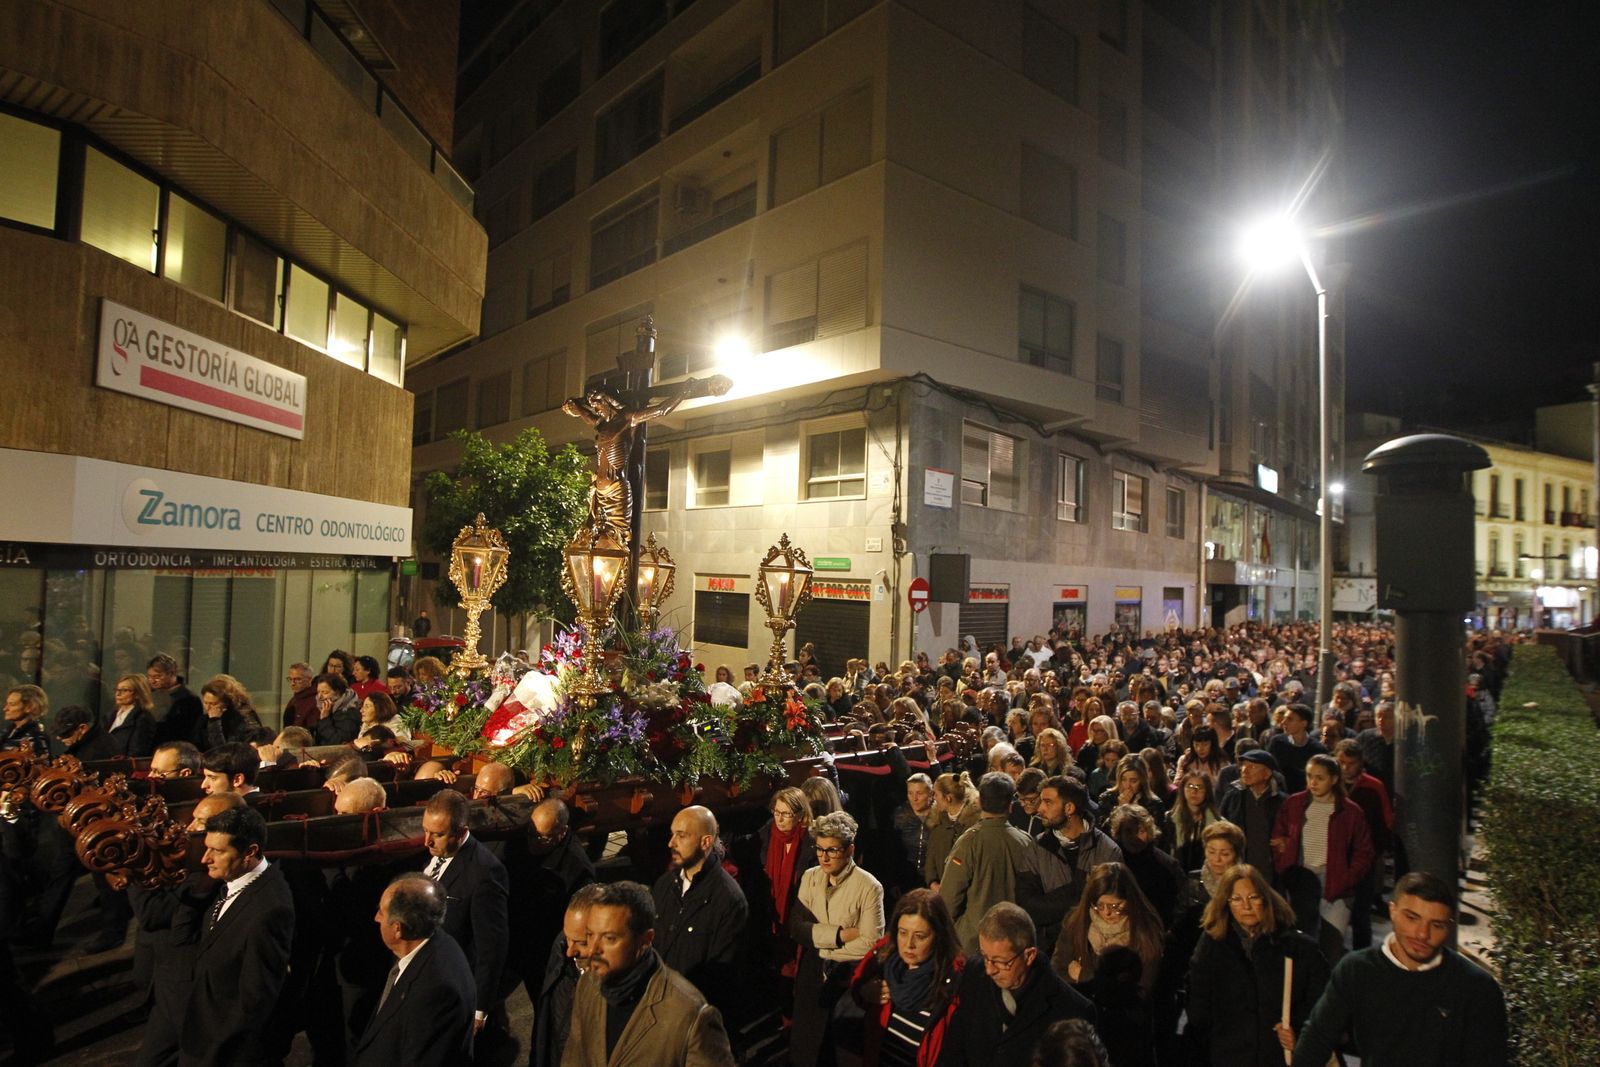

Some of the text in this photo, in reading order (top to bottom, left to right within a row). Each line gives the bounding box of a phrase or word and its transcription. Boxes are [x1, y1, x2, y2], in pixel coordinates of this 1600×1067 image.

[145, 329, 239, 388] GESTORÍA
[243, 366, 300, 408] GLOBAL
[137, 488, 405, 543] Zamora CENTRO ODONTOLÓGICO
[95, 551, 192, 567] ORTODONCIA
